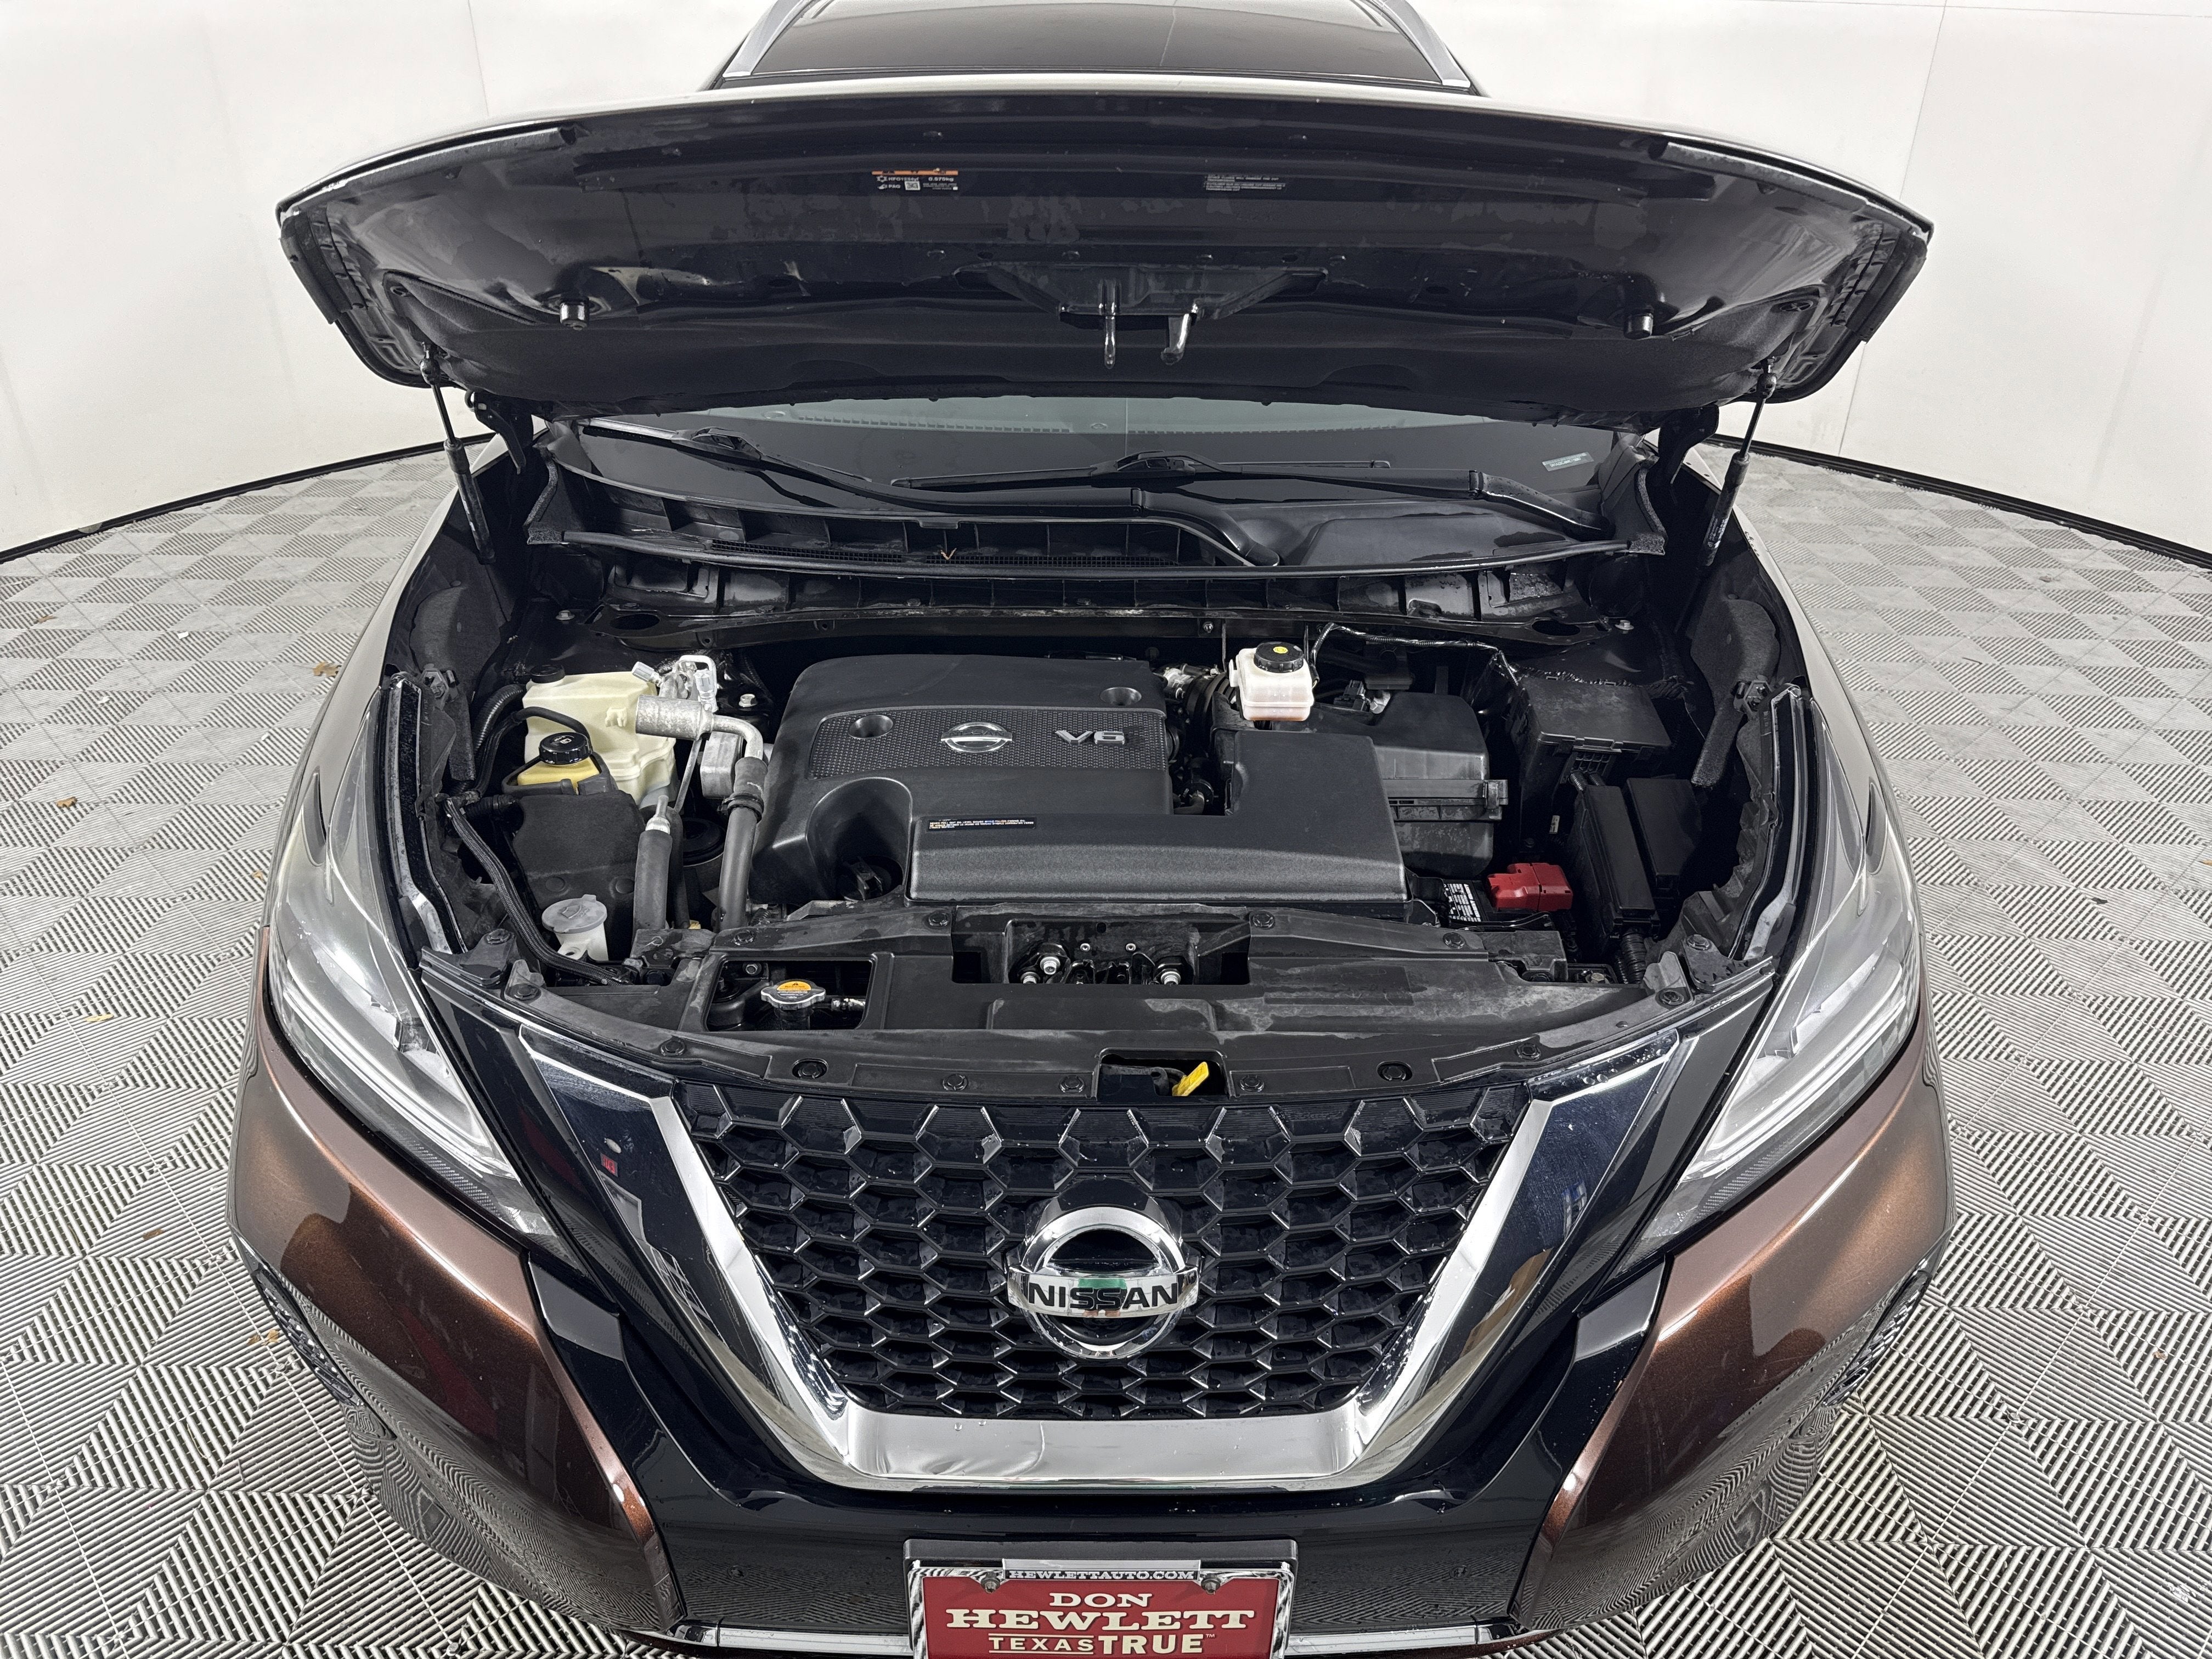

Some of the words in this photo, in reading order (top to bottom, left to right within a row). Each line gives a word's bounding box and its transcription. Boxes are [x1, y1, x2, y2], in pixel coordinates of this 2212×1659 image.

[1054, 730, 1126, 745] V6
[1029, 1282, 1178, 1310] NISSAN
[1009, 1571, 1194, 1579] HEWLETTAUTO.COM
[1049, 1593, 1153, 1607] DON
[945, 1609, 1255, 1630] HEWLETT
